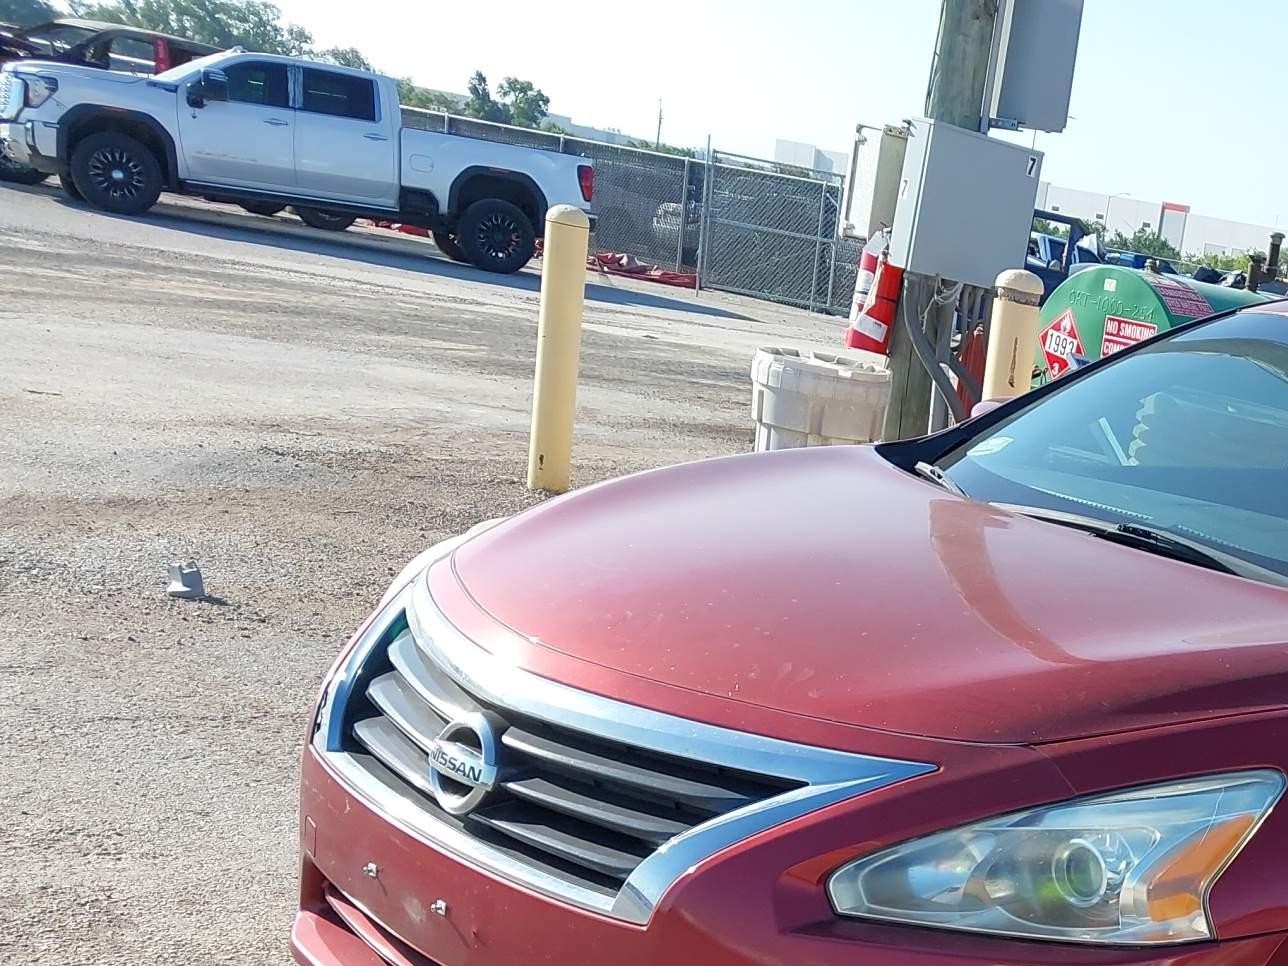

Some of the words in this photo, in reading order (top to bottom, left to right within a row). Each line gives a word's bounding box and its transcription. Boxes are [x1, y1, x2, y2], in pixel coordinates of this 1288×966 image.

[1027, 157, 1036, 176] 7
[901, 180, 908, 197] 7
[1107, 320, 1119, 334] NO
[1120, 322, 1155, 340] SMOKING
[1052, 362, 1060, 375] 3
[430, 747, 482, 782] NISSAN
